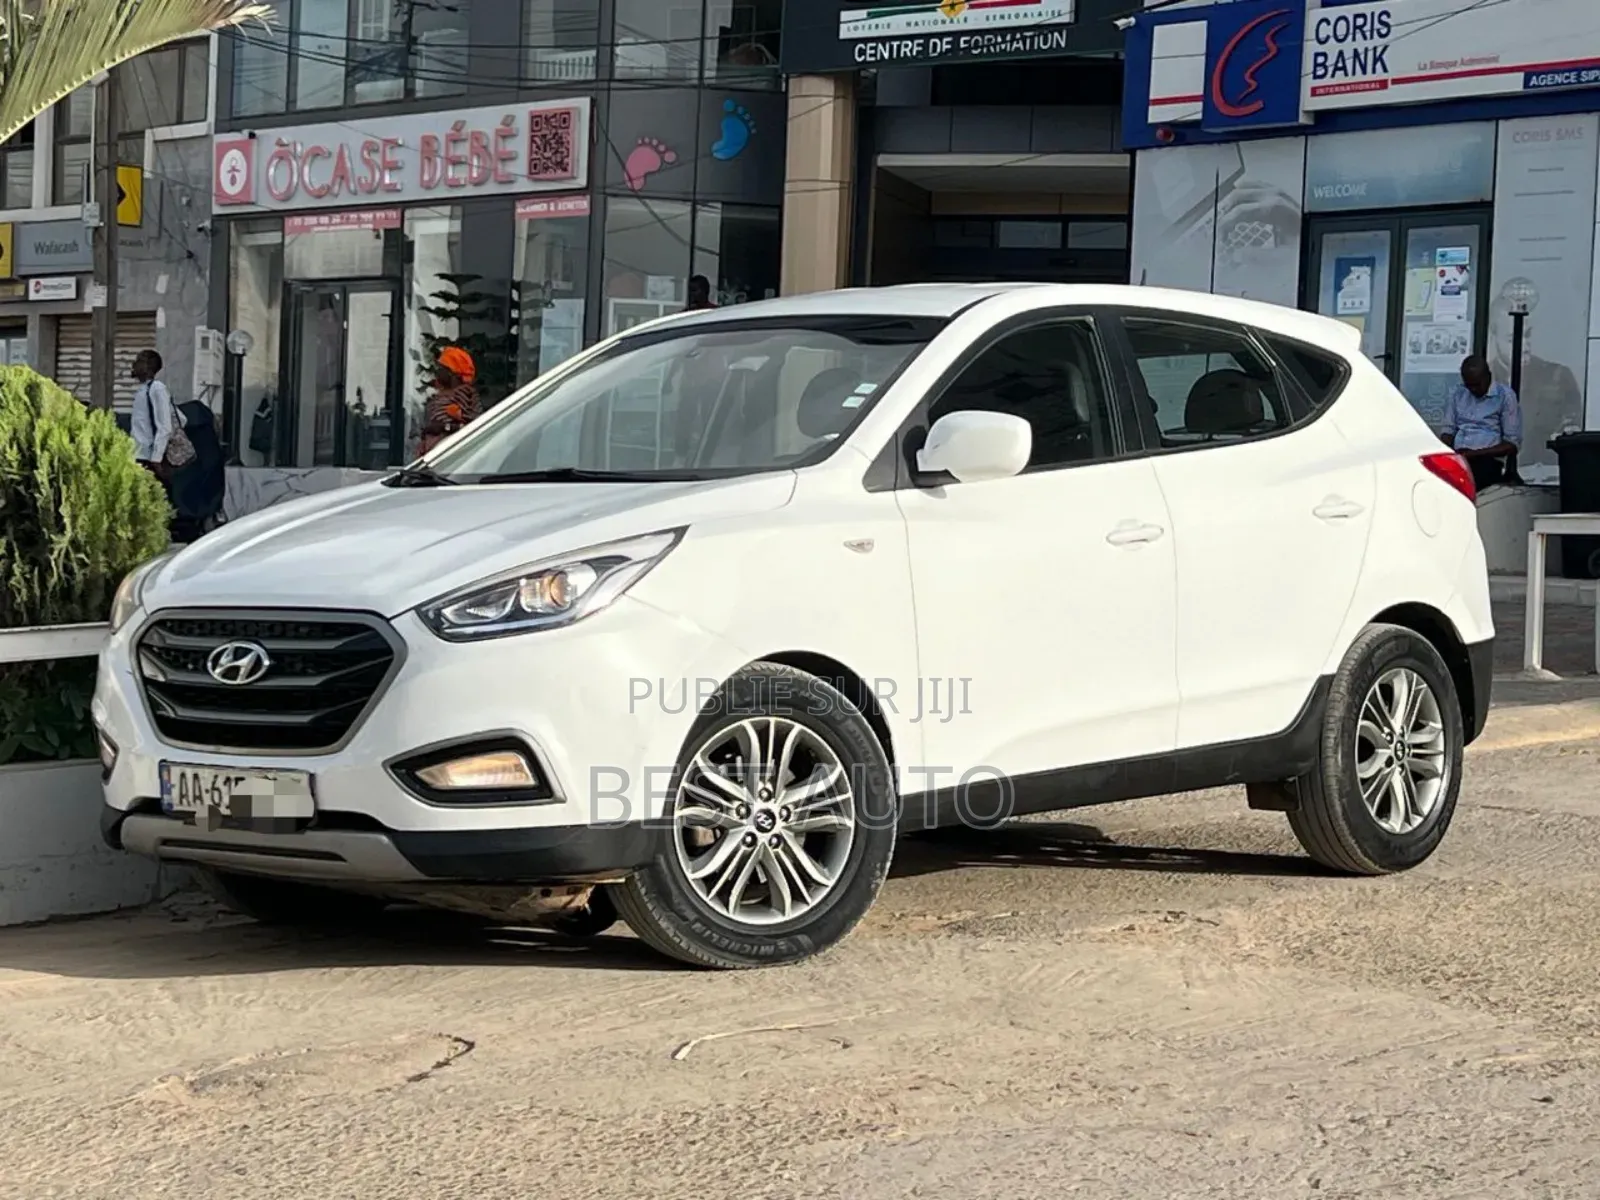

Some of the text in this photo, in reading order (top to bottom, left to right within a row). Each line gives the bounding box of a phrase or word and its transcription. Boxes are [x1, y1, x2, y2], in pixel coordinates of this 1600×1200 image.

[905, 16, 969, 29] NATIONALE
[1315, 9, 1392, 45] CORIS
[853, 29, 1068, 62] CENTRE DE FORMATION
[1312, 44, 1390, 80] BANK
[1529, 72, 1577, 87] AGENCE
[1556, 126, 1584, 141] SMS
[419, 113, 518, 189] BÉBÉ
[1313, 182, 1368, 199] WELCOME
[33, 241, 79, 256] Wafacash
